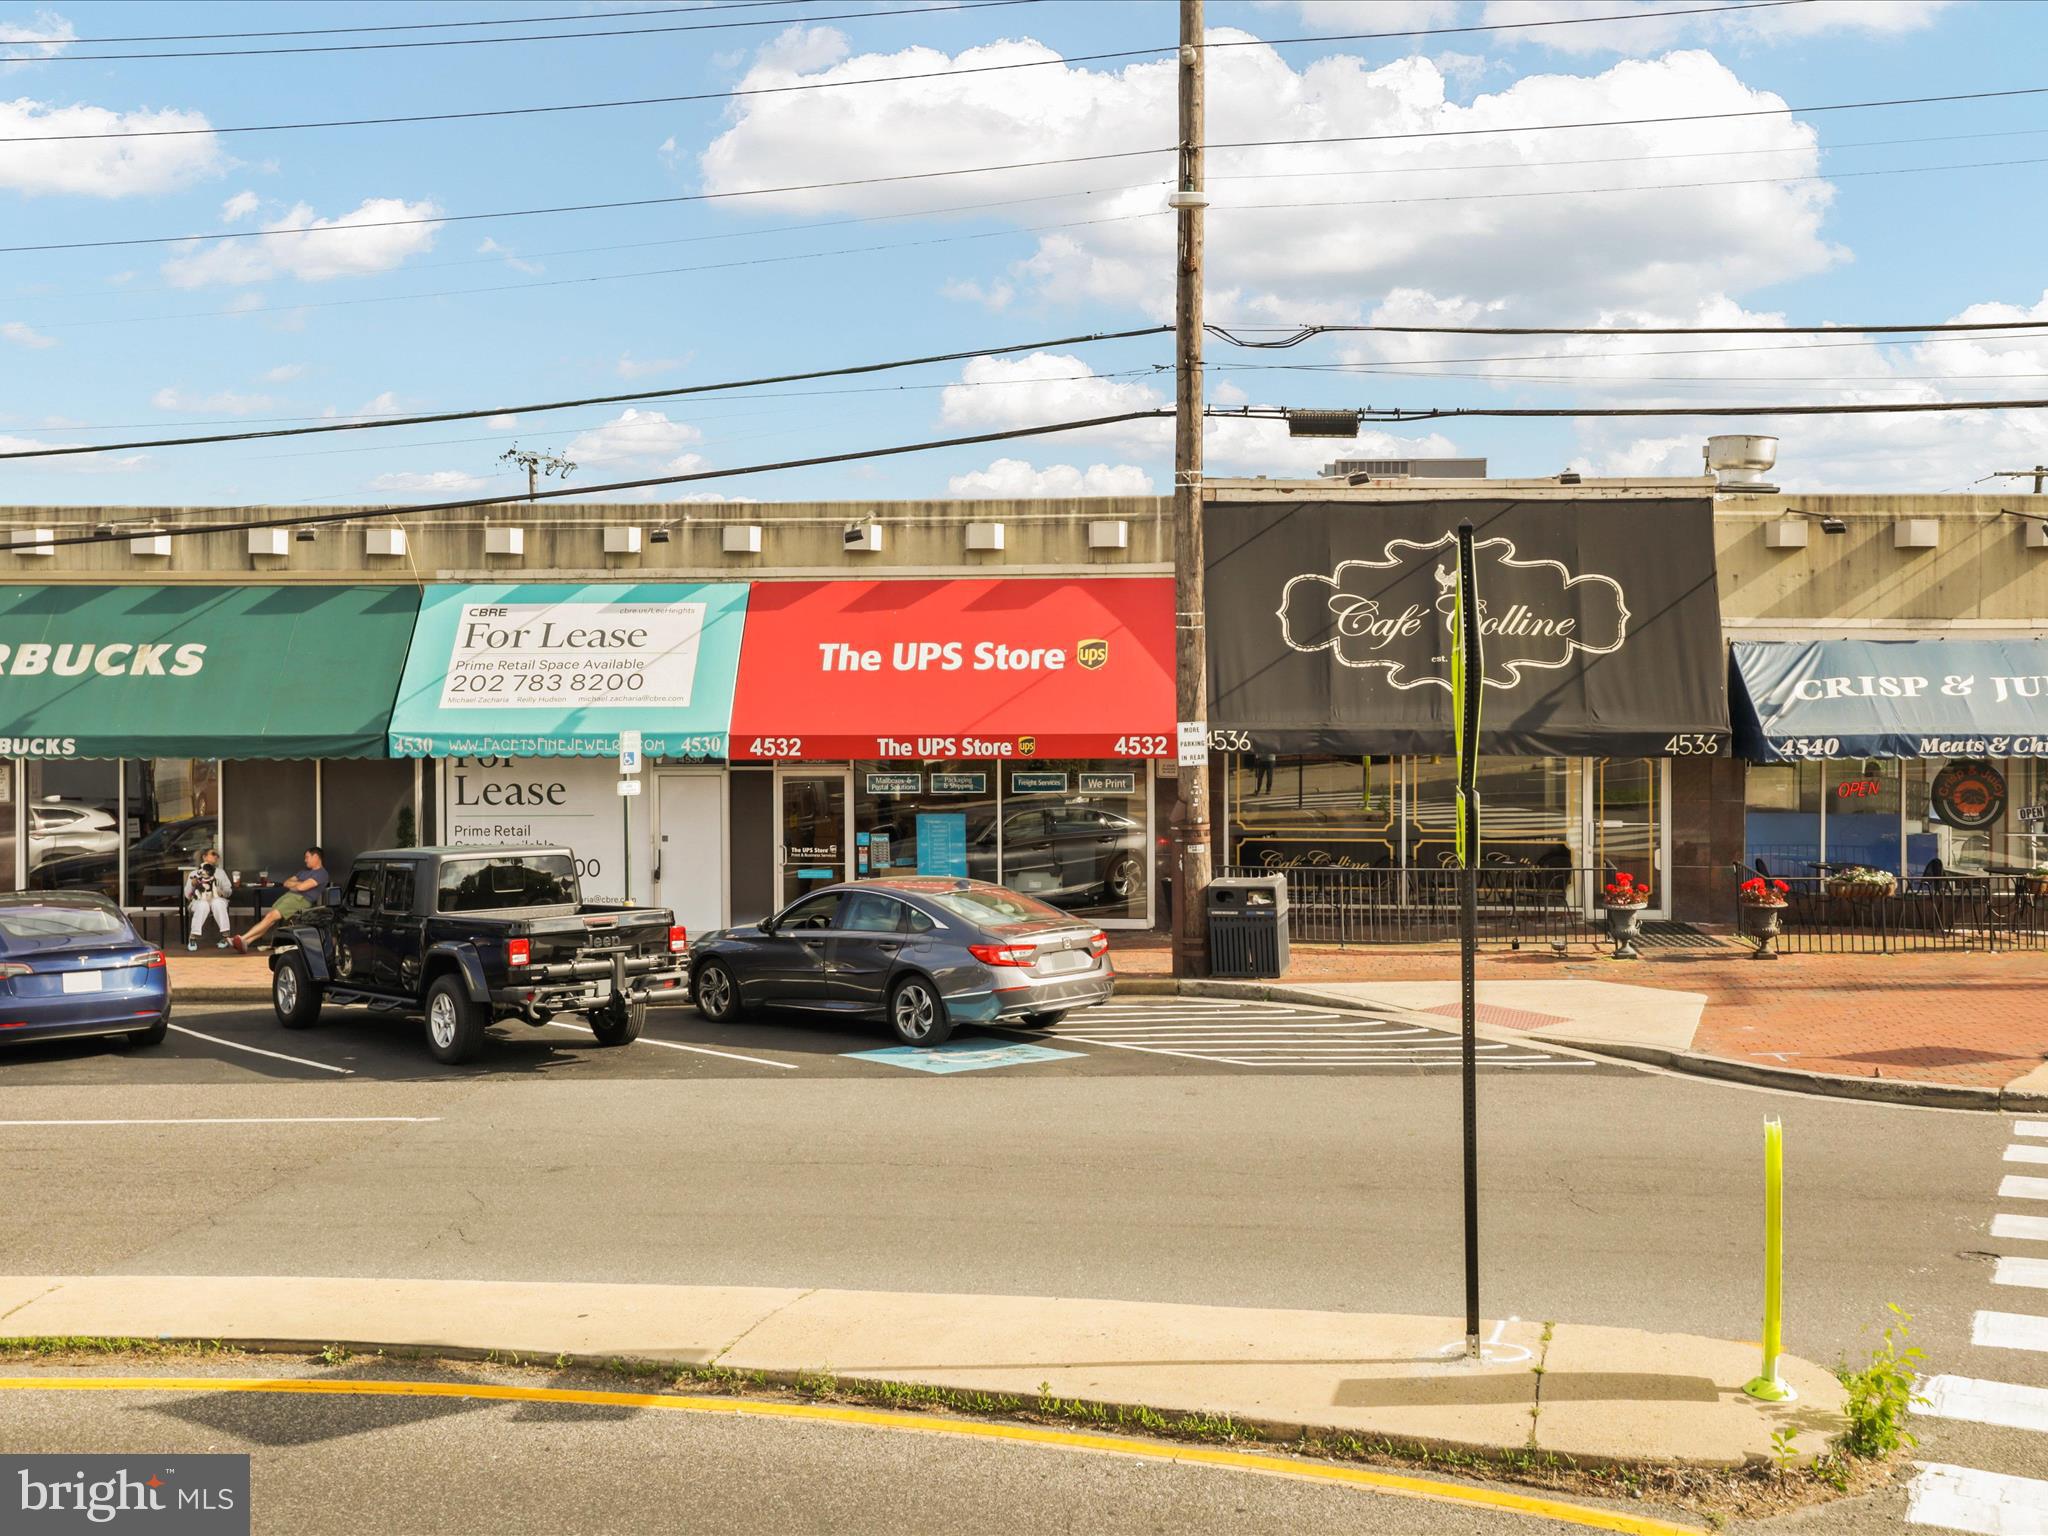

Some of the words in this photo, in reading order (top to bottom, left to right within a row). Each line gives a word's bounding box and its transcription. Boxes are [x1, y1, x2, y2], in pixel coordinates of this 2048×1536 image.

[469, 608, 508, 617] CBRE
[1328, 593, 1430, 650] Café
[462, 622, 531, 649] For
[538, 622, 648, 649] Lease
[455, 660, 494, 671] Prime
[498, 659, 535, 670] Retail
[539, 659, 580, 671] Space
[583, 658, 645, 670] Available
[819, 643, 882, 671] The
[892, 642, 962, 671] UPS
[973, 641, 1066, 670] Store
[1079, 646, 1105, 665] ups
[1431, 655, 1448, 663] est.
[451, 674, 504, 692] 202
[513, 674, 562, 692] 783
[570, 673, 644, 691] 8200
[1795, 675, 1928, 701] CRISP
[1941, 675, 1974, 696] &
[394, 737, 433, 753] 4530
[681, 737, 721, 752] 4530
[750, 738, 801, 756] 4532
[877, 738, 912, 756] The
[918, 738, 956, 756] UPS
[962, 738, 1013, 755] Store
[1114, 736, 1168, 755] 4532
[1664, 734, 1718, 755] 4536
[1780, 738, 1840, 756] 4540
[1919, 738, 1985, 753] Meats
[1988, 736, 2010, 753] &
[454, 775, 567, 806] Lease
[1018, 779, 1037, 787] Freight
[1088, 779, 1104, 788] We
[1105, 778, 1126, 788] Print
[1837, 780, 1881, 799] OPEN
[2020, 807, 2043, 819] OPEN
[454, 825, 491, 837] Prime
[494, 825, 531, 837] Retail
[583, 934, 621, 948] Jeep
